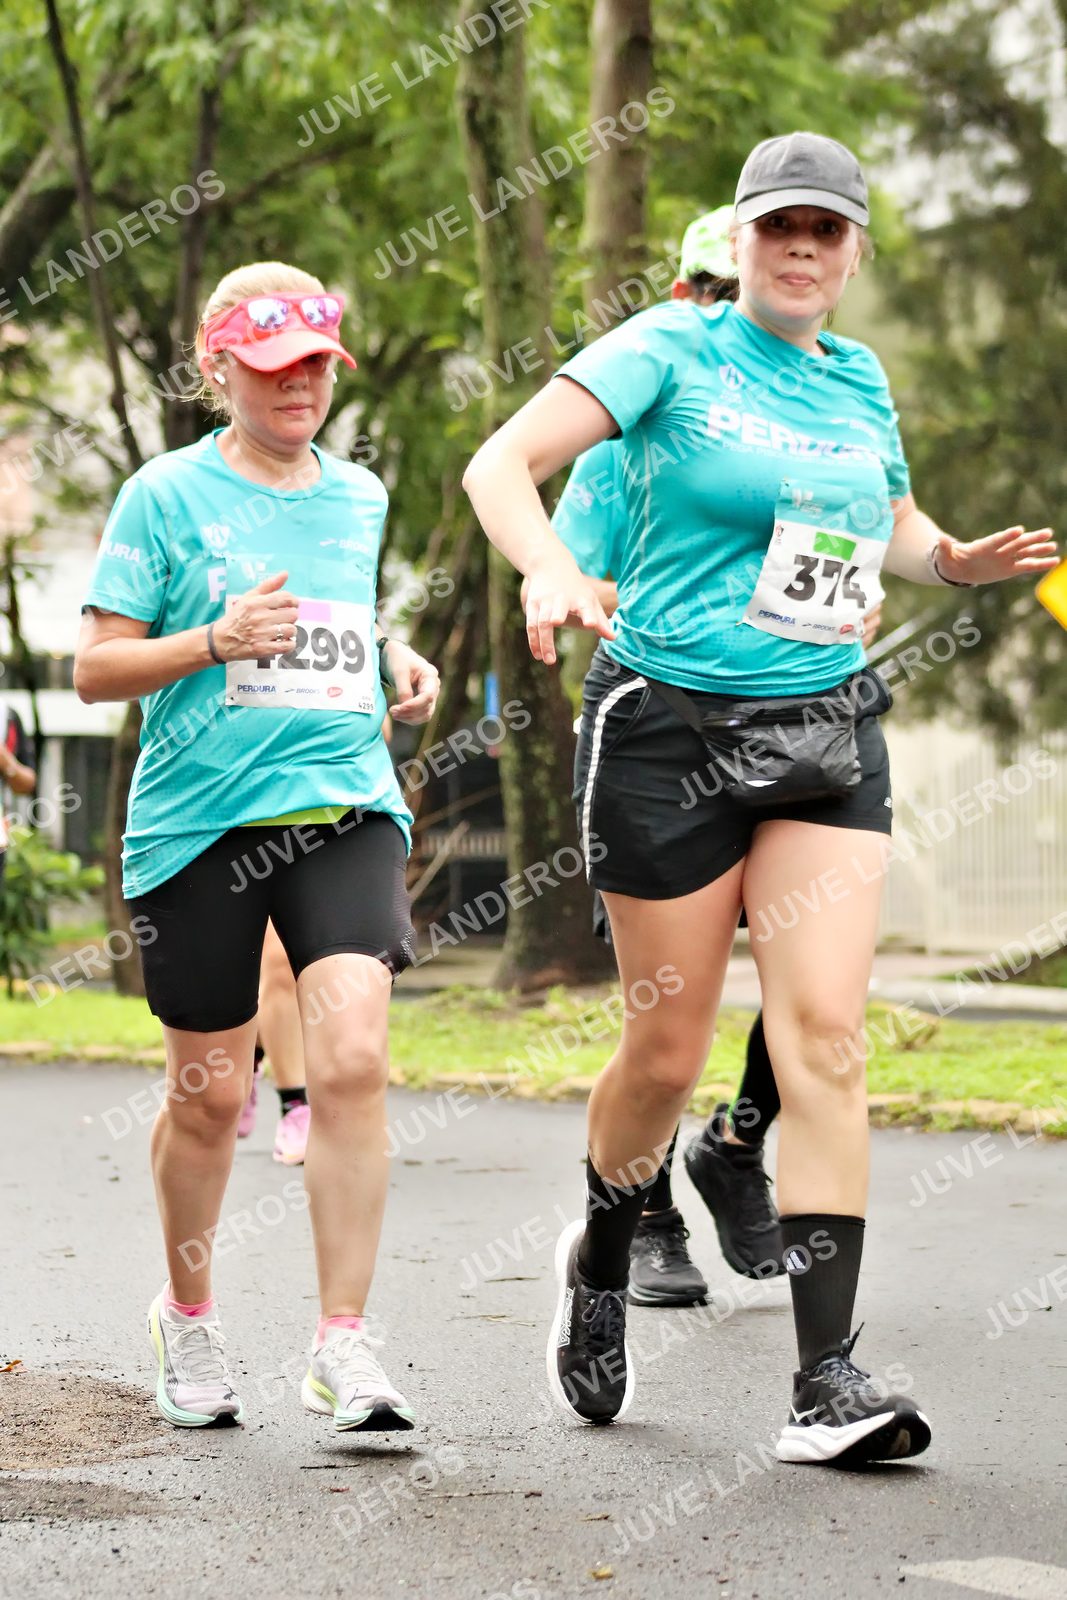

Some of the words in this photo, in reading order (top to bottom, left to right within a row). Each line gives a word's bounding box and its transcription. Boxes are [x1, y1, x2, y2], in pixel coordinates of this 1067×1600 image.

[783, 553, 867, 609] 374
[758, 609, 796, 625] PERDURA
[256, 624, 366, 674] 299
[237, 684, 277, 694] PERDURA
